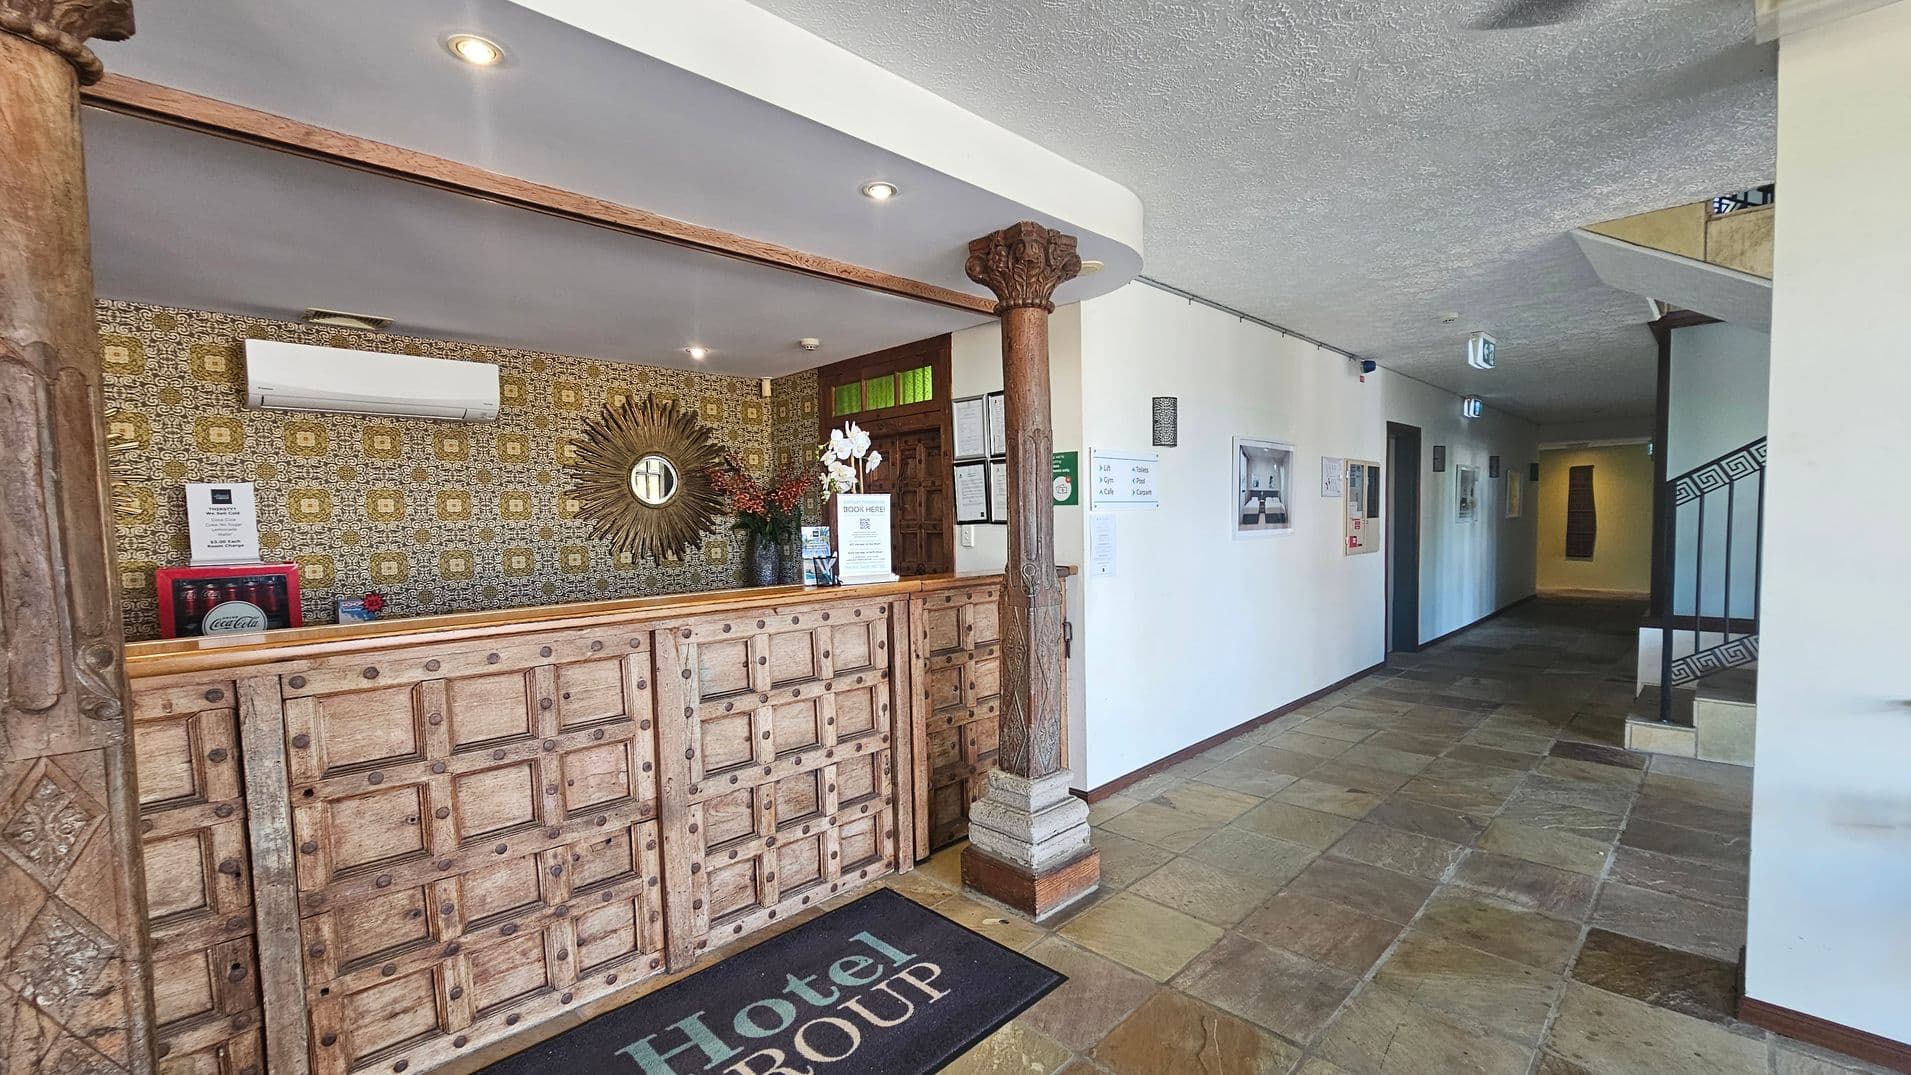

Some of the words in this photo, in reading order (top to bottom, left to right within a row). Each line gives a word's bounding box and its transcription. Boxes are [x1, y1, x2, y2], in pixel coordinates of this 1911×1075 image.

[843, 505, 864, 513] BOOK
[865, 505, 886, 513] HERE!
[615, 931, 918, 1075] Hotel
